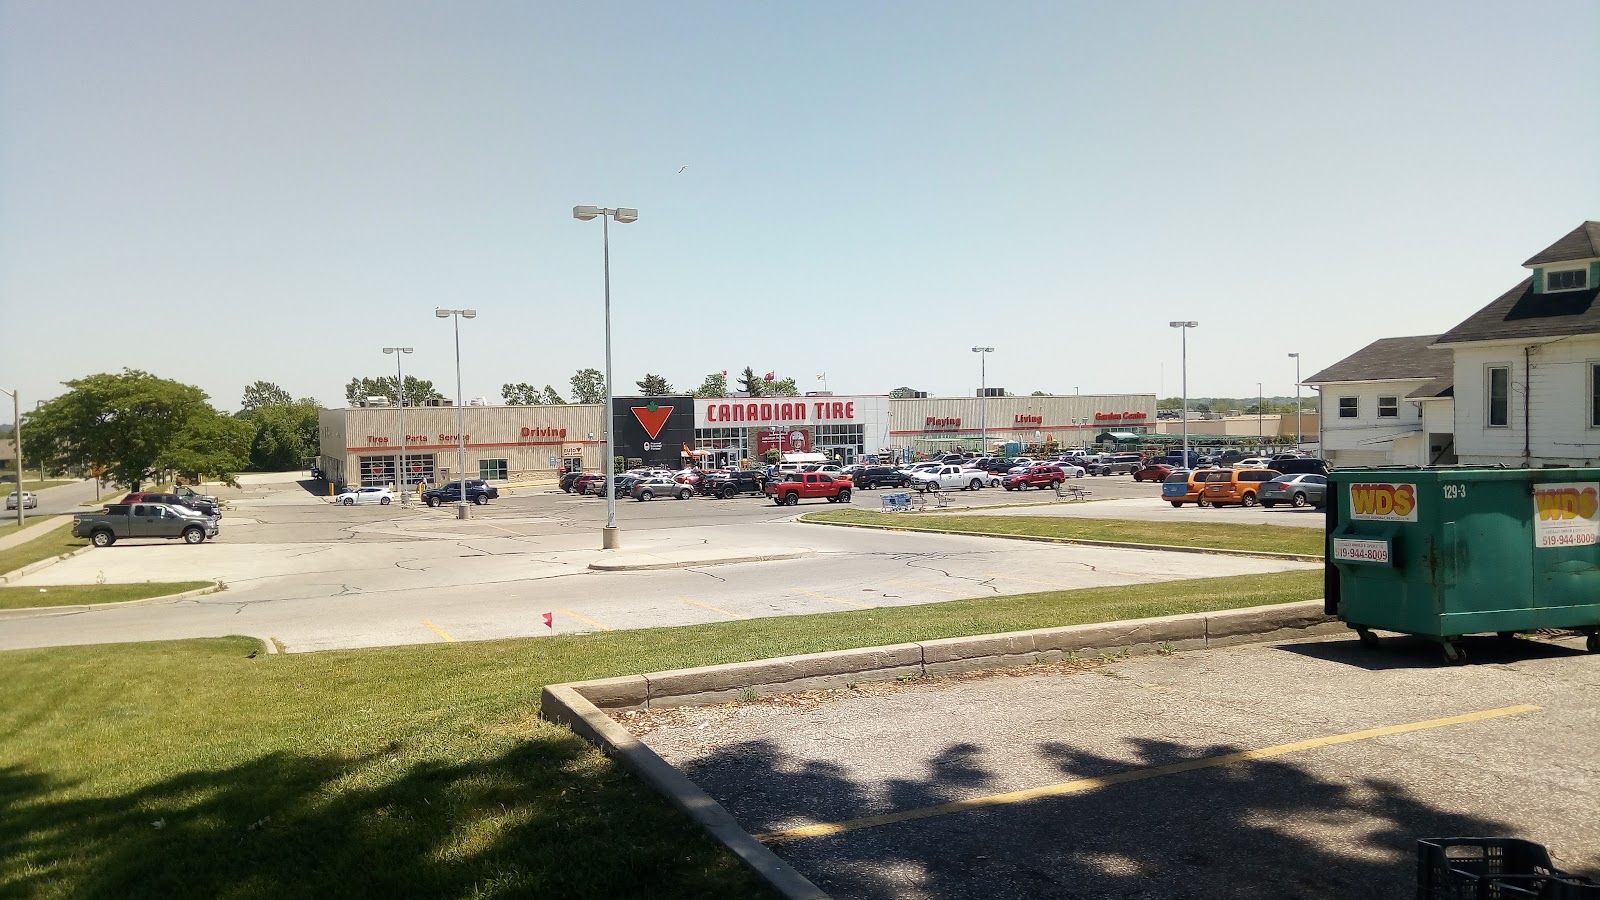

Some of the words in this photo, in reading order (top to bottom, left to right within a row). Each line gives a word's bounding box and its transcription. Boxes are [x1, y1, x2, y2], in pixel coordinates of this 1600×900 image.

[707, 402, 806, 422] CANADIAN
[814, 401, 854, 419] TIRE
[1095, 412, 1121, 421] Garden
[926, 416, 961, 427] Playing
[1015, 414, 1042, 424] Living
[367, 435, 389, 443] Tires
[405, 434, 428, 442] Parts
[521, 426, 567, 439] Driving
[1443, 484, 1466, 499] 129-3
[1351, 484, 1415, 516] WDS
[1533, 487, 1598, 521] WDS
